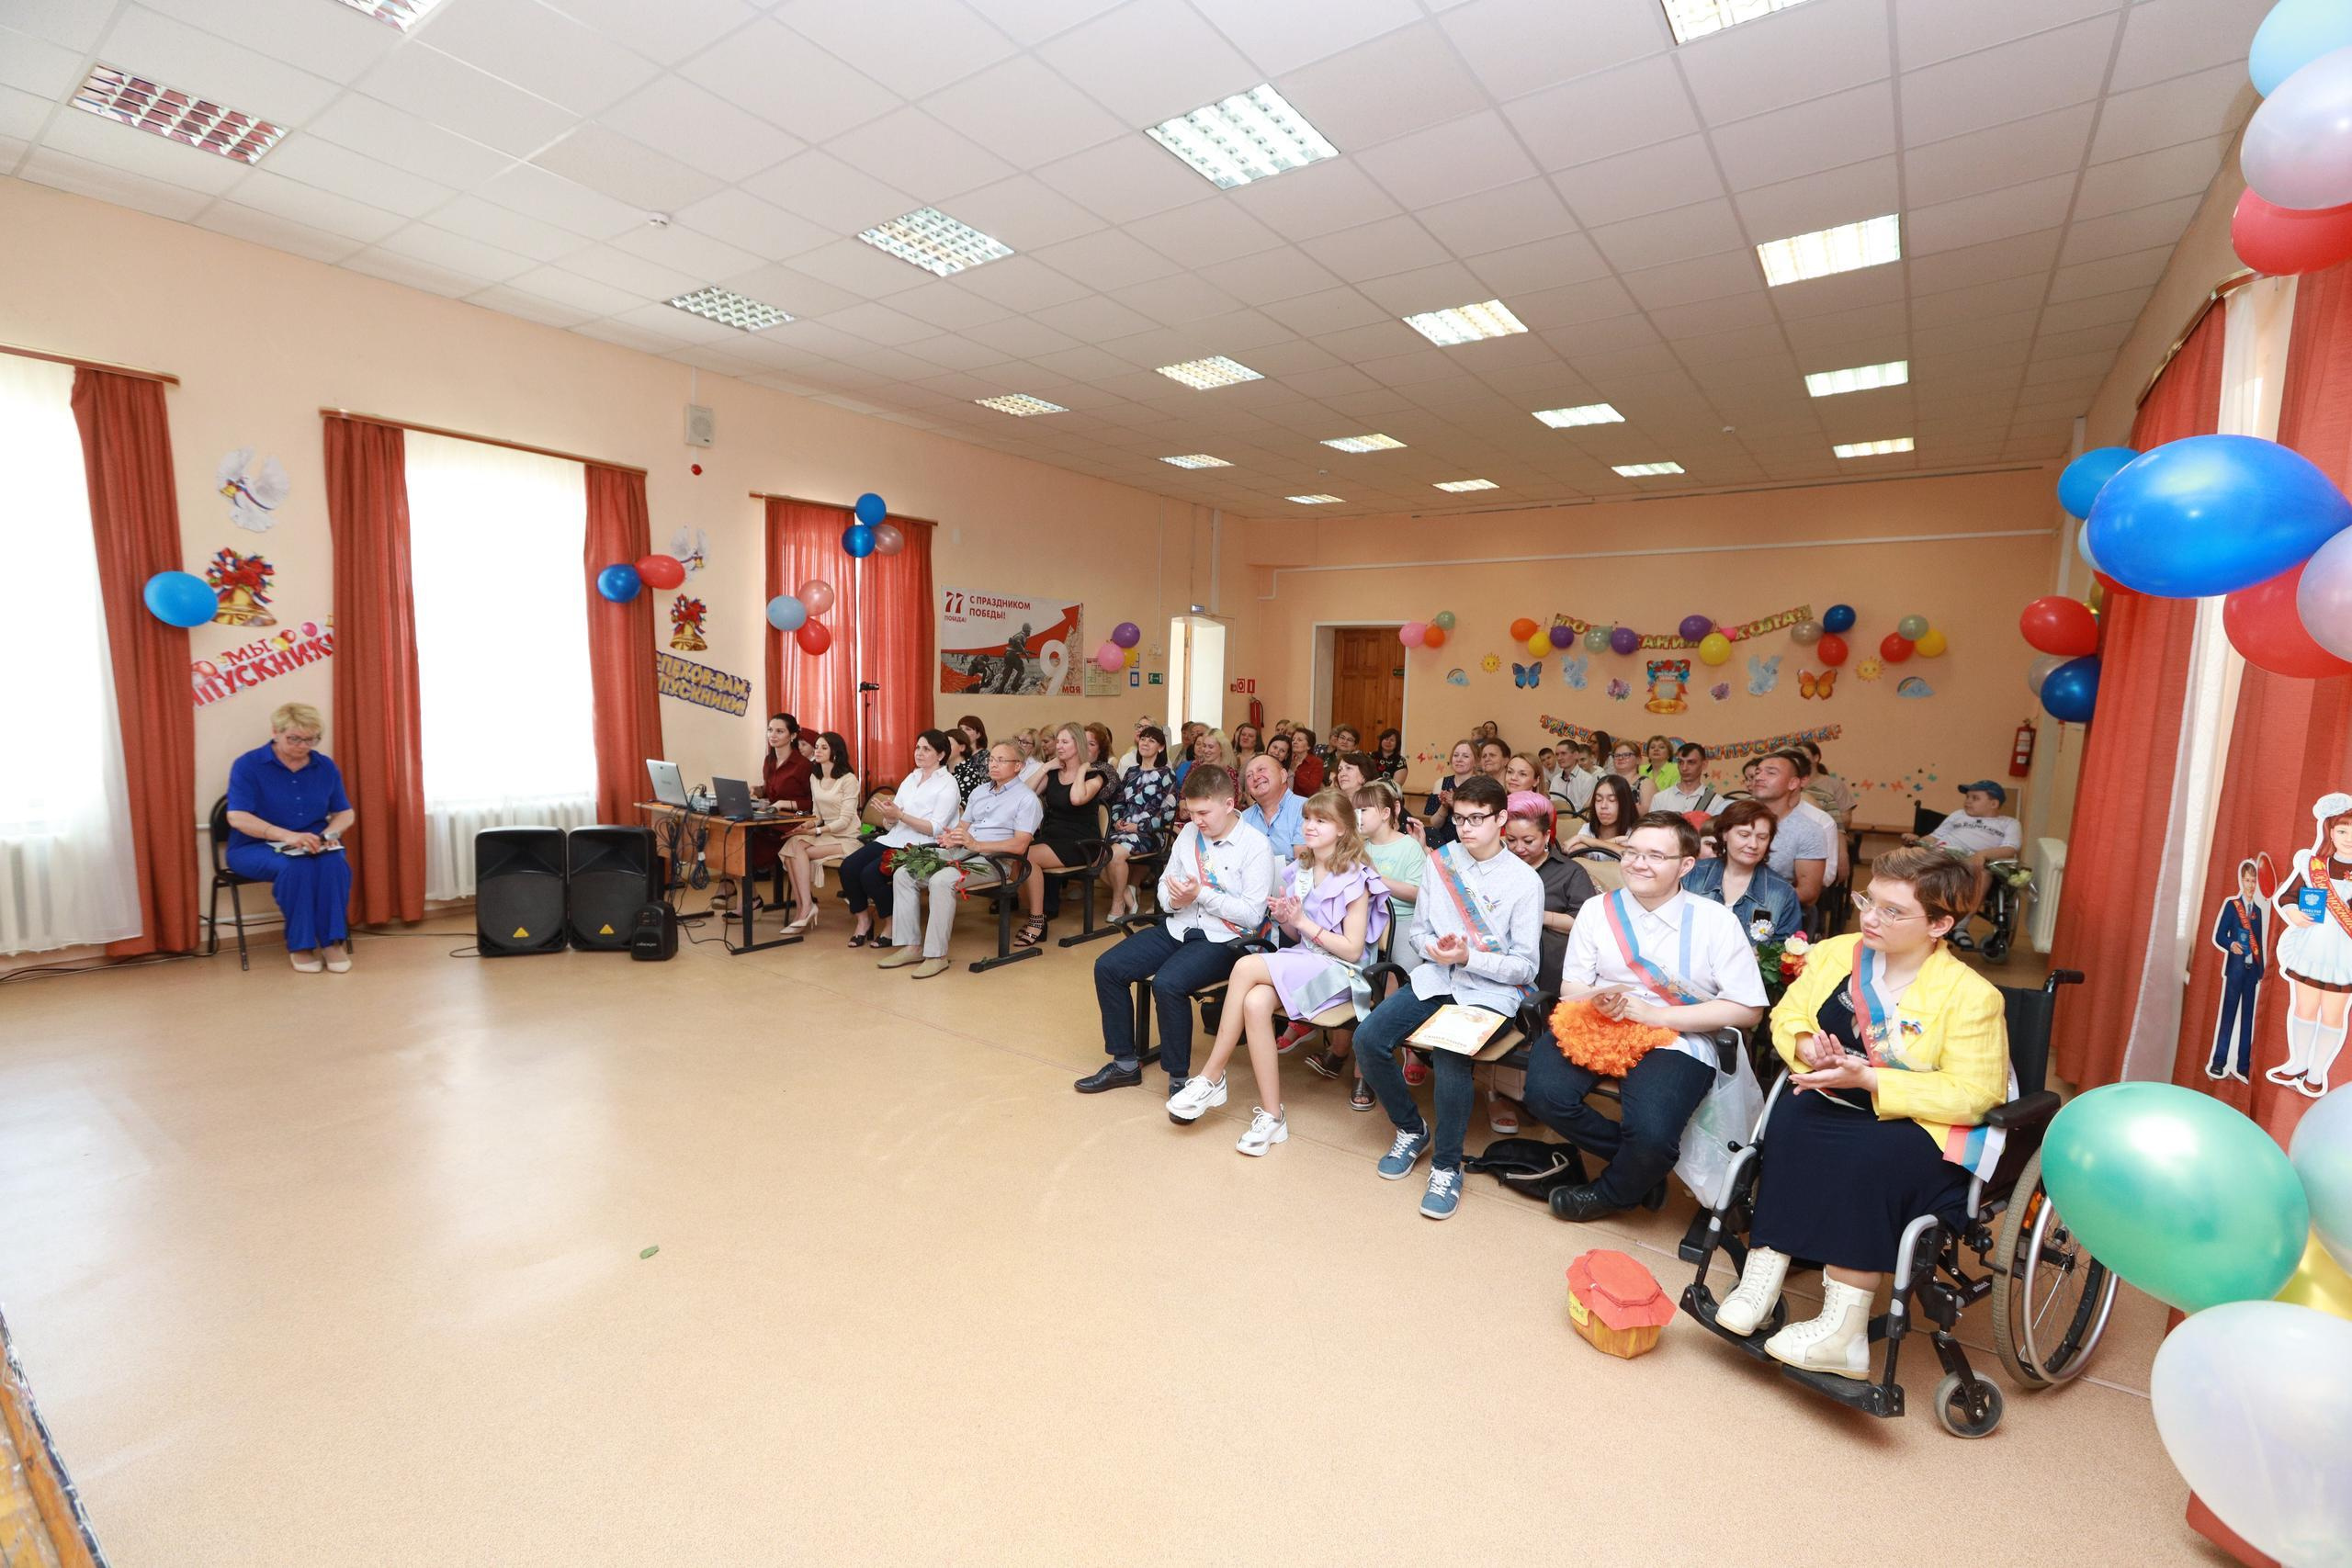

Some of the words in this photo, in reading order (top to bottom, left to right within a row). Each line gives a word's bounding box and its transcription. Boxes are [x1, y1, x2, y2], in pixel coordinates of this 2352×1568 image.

[944, 591, 965, 614] 77
[969, 608, 1006, 620] ПОБЕДЫ!
[976, 596, 1031, 610] ПРАЗДНИКОМ
[220, 638, 273, 666] МЫ
[1040, 639, 1069, 695] 9
[191, 634, 334, 706] ПУСКНИК
[657, 653, 712, 685] ПЕХОВ
[658, 676, 747, 715] ПУСКНИКИ
